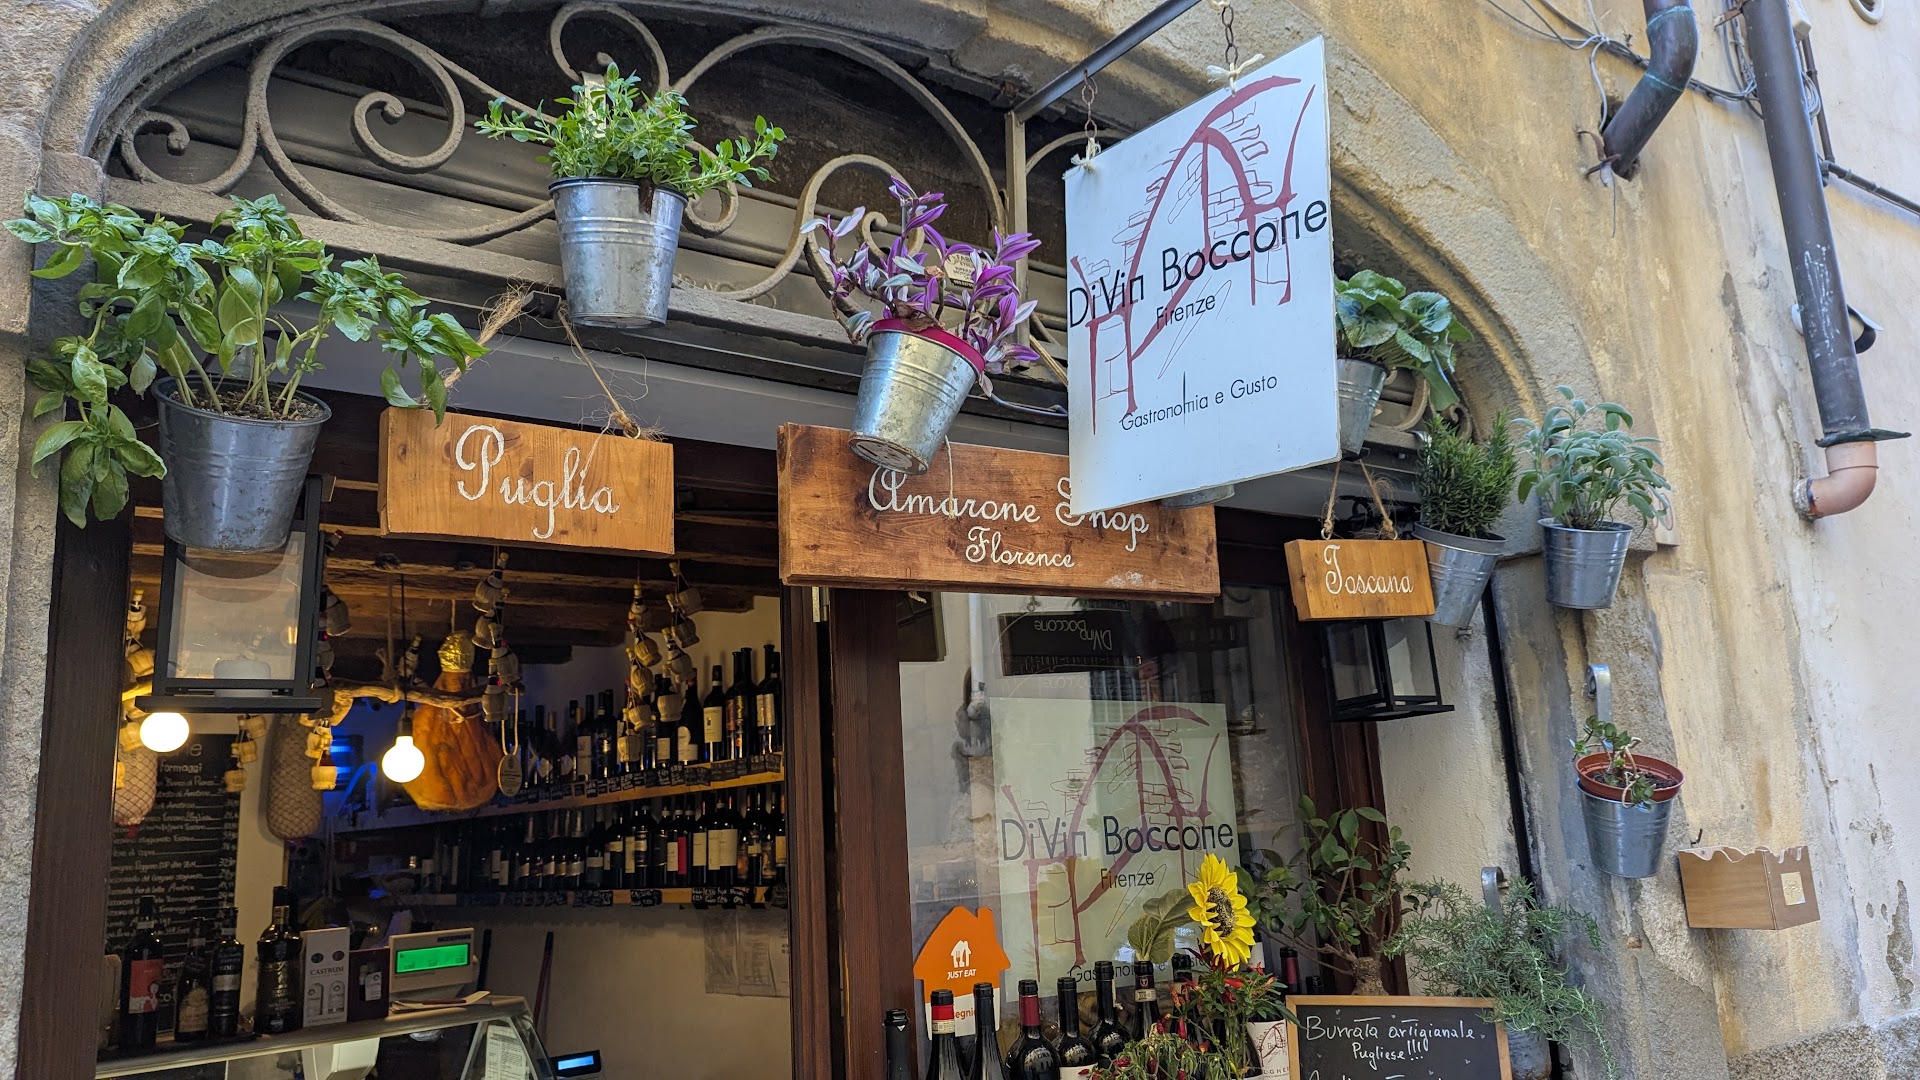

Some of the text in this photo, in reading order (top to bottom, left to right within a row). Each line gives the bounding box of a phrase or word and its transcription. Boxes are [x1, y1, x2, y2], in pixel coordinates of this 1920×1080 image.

[1068, 200, 1328, 329] DiVin Boccone
[1156, 291, 1217, 331] Firenze
[1119, 373, 1278, 432] Gastronomia e Gusto
[455, 425, 621, 540] Puglia
[868, 466, 1041, 524] Amarone
[965, 526, 1075, 568] Florence
[1323, 544, 1414, 595] Toscana
[1001, 816, 1234, 861] DiVin Boccone
[1100, 867, 1155, 890] Firenze
[309, 966, 345, 976] CASTRUM
[947, 968, 977, 980] JUST EAT
[1306, 1015, 1476, 1050] Burrata artigianale
